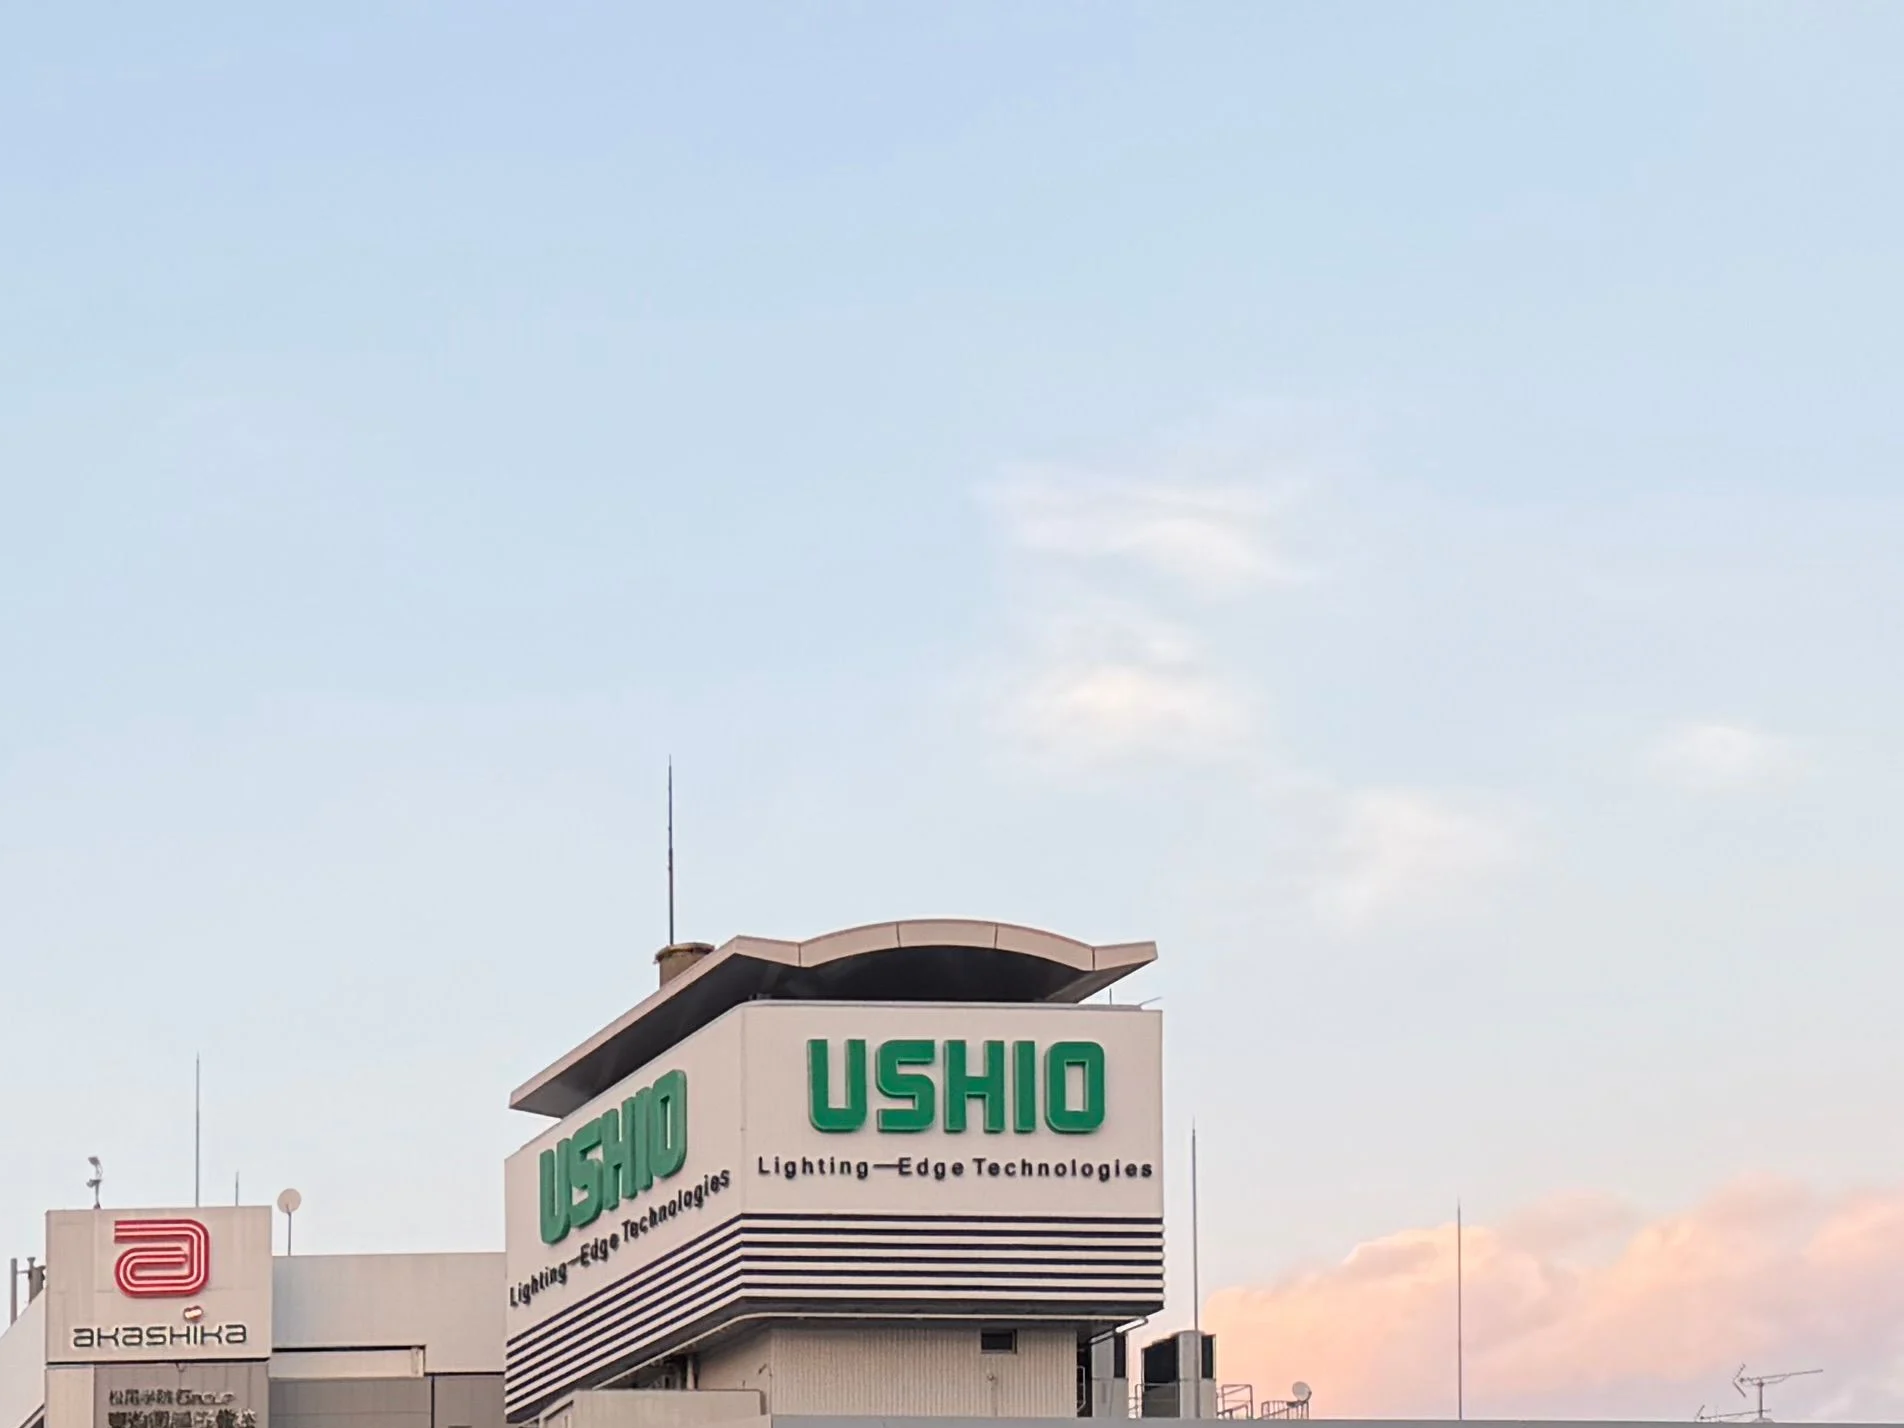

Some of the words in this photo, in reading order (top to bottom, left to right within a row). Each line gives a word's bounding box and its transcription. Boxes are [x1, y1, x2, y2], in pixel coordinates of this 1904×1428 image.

[807, 1038, 1106, 1135] USHIO
[539, 1068, 688, 1246] USHIO
[972, 1156, 1154, 1181] Technologies
[621, 1168, 731, 1245] Technologies
